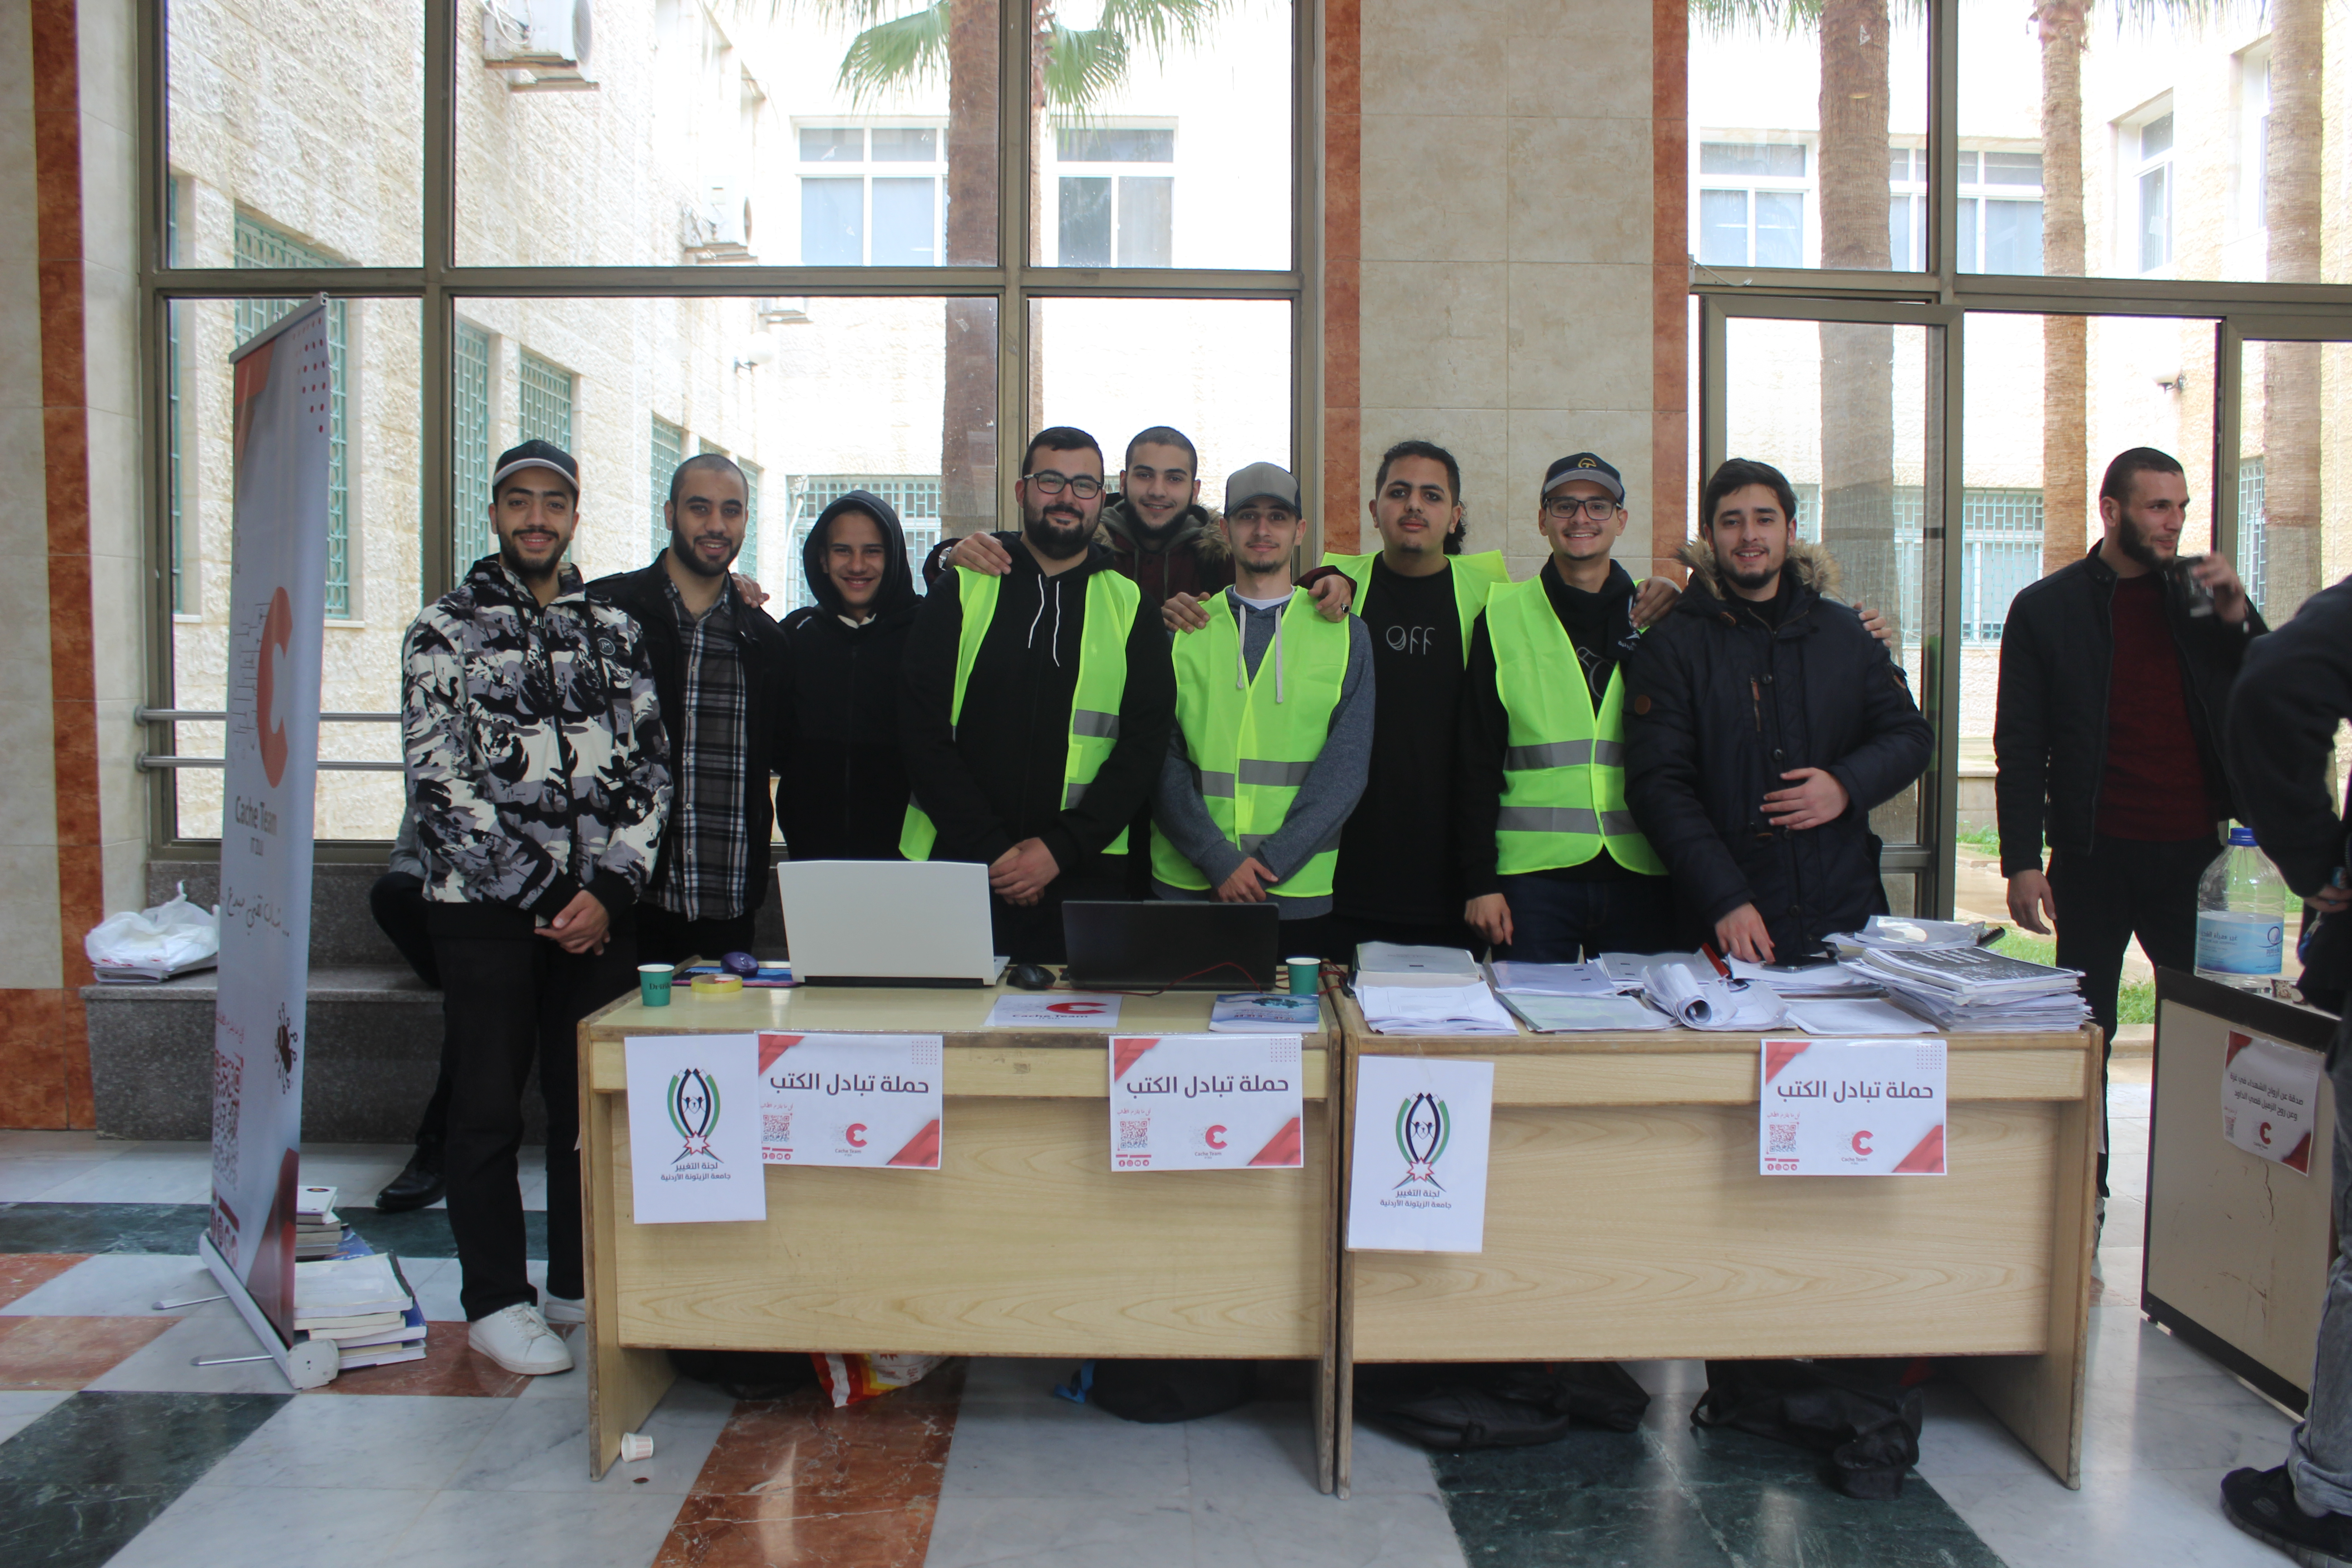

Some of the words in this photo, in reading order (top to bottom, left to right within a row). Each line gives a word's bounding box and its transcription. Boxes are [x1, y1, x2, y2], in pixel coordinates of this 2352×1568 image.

[235, 795, 259, 829] Cache
[260, 801, 278, 837] Team
[770, 1073, 819, 1093] الكتب
[826, 1074, 876, 1097] تبادل
[880, 1076, 929, 1093] حملة
[1127, 1076, 1177, 1099] الكتب
[1184, 1075, 1234, 1098] تبادل
[1239, 1074, 1289, 1092] حملة
[2247, 1080, 2267, 1092] الشهداء
[1777, 1080, 1827, 1102] الكتب
[1833, 1080, 1881, 1103] تبادل
[1886, 1081, 1933, 1098] حملة
[2267, 1087, 2280, 1098] أرواح
[2288, 1094, 2304, 1105] صدقة
[2261, 1100, 2276, 1112] الزميل
[2277, 1107, 2286, 1117] روح
[2286, 1111, 2298, 1122] وعن
[675, 1162, 699, 1172] التغيير
[701, 1162, 718, 1171] لجنة
[661, 1173, 683, 1182] الأردنية
[685, 1173, 709, 1181] الزيتونة
[1395, 1189, 1421, 1198] التغيير
[1423, 1190, 1440, 1200] لجنة
[1380, 1199, 1403, 1208] الأردنية
[1404, 1200, 1430, 1209] الزيتونة
[1431, 1201, 1452, 1210] جامعة
